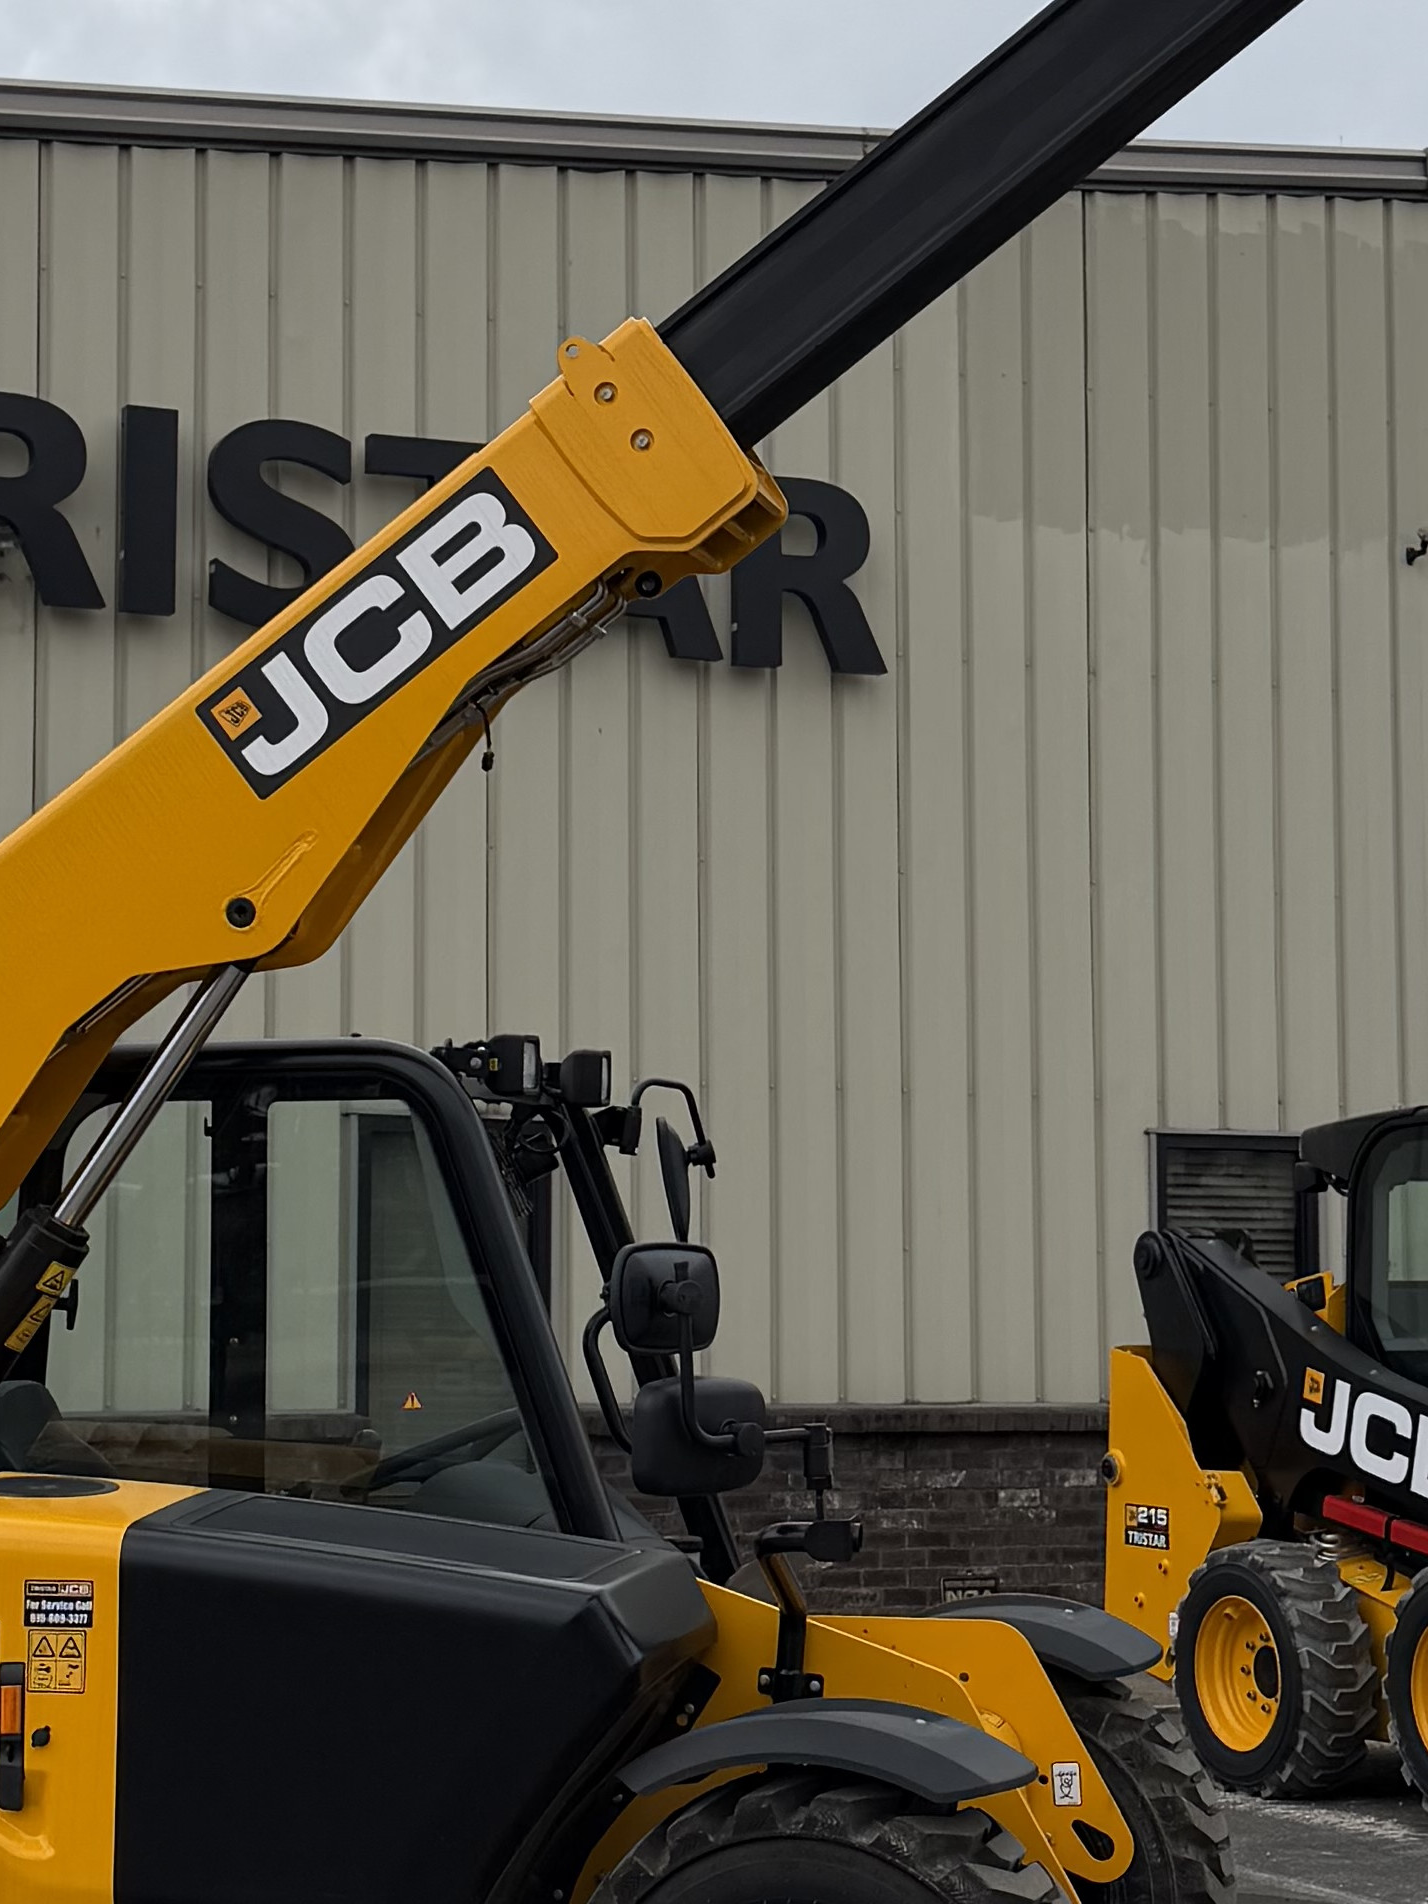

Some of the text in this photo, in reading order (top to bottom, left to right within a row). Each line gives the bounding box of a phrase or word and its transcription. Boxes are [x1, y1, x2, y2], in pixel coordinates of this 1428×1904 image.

[241, 490, 538, 777] JCB
[1137, 1506, 1167, 1526] 215
[1127, 1530, 1167, 1548] TRISTAR
